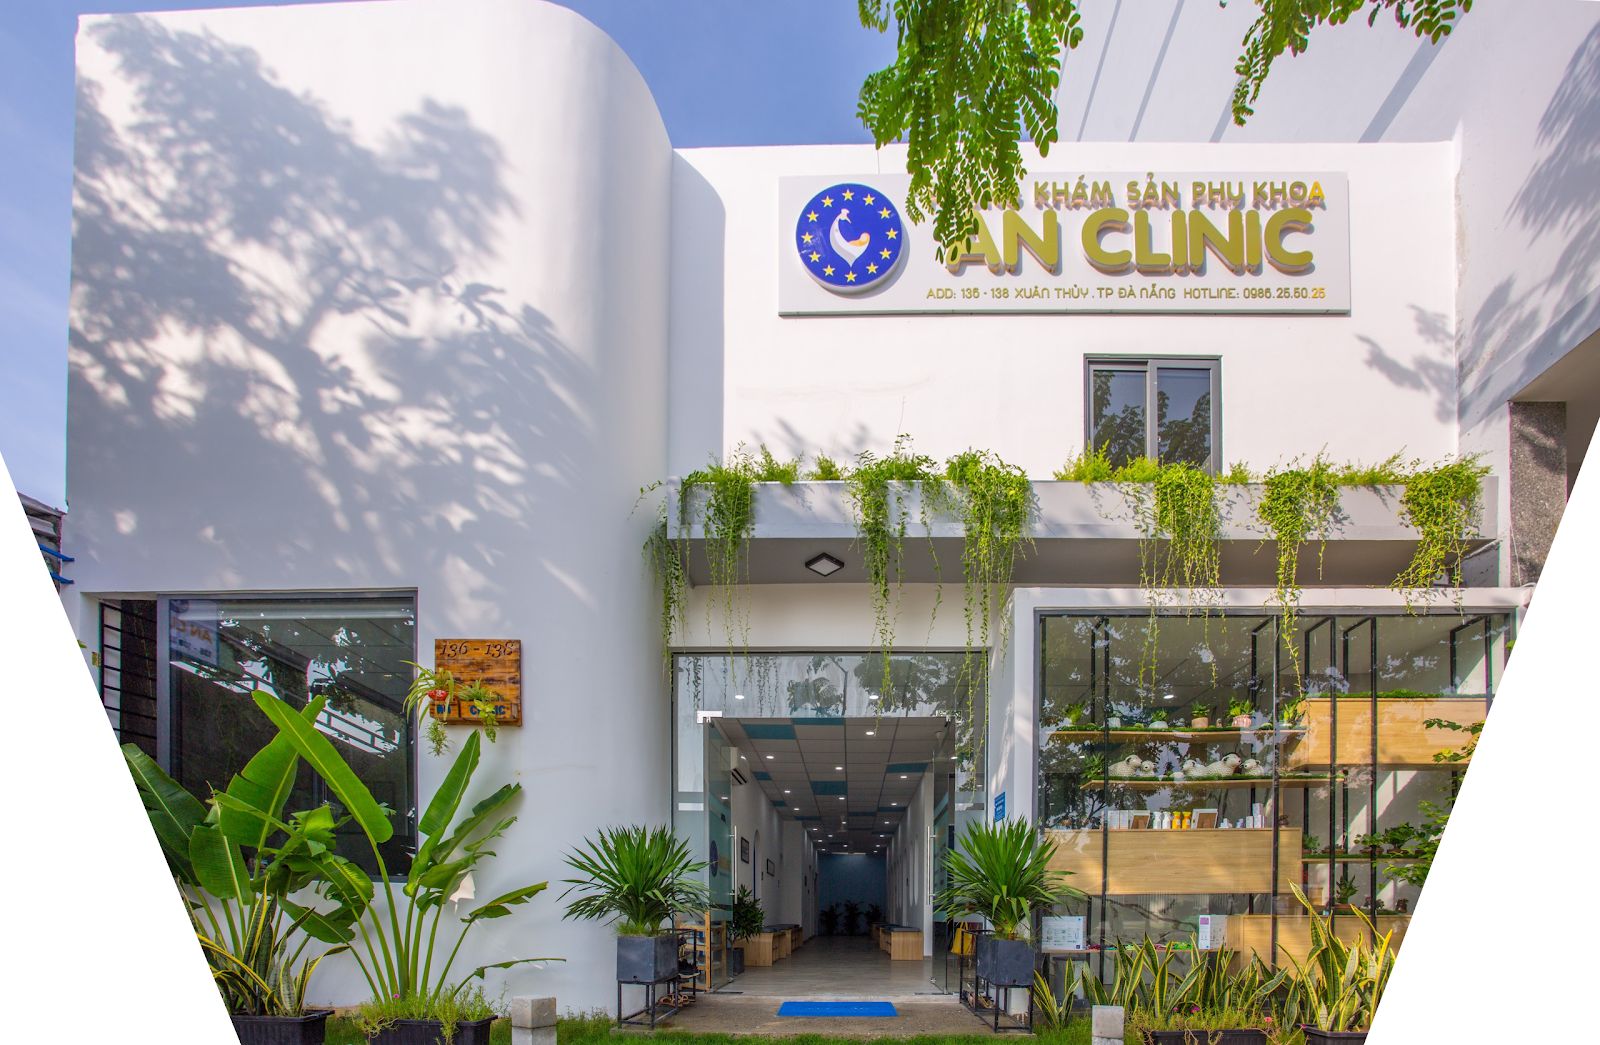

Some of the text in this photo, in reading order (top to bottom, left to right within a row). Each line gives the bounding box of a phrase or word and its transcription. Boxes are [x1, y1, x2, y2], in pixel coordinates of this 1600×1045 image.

[1033, 174, 1113, 206] KHÁM
[1127, 172, 1178, 206] SẢN
[1253, 180, 1325, 205] KHOA
[945, 207, 1314, 270] AN CLINIC
[926, 287, 957, 299] ADD:
[990, 287, 1010, 299] 138
[1118, 285, 1137, 299] ĐÀ
[1183, 287, 1240, 299] HOTLINE:
[440, 641, 468, 658] 136
[484, 640, 514, 658] 138
